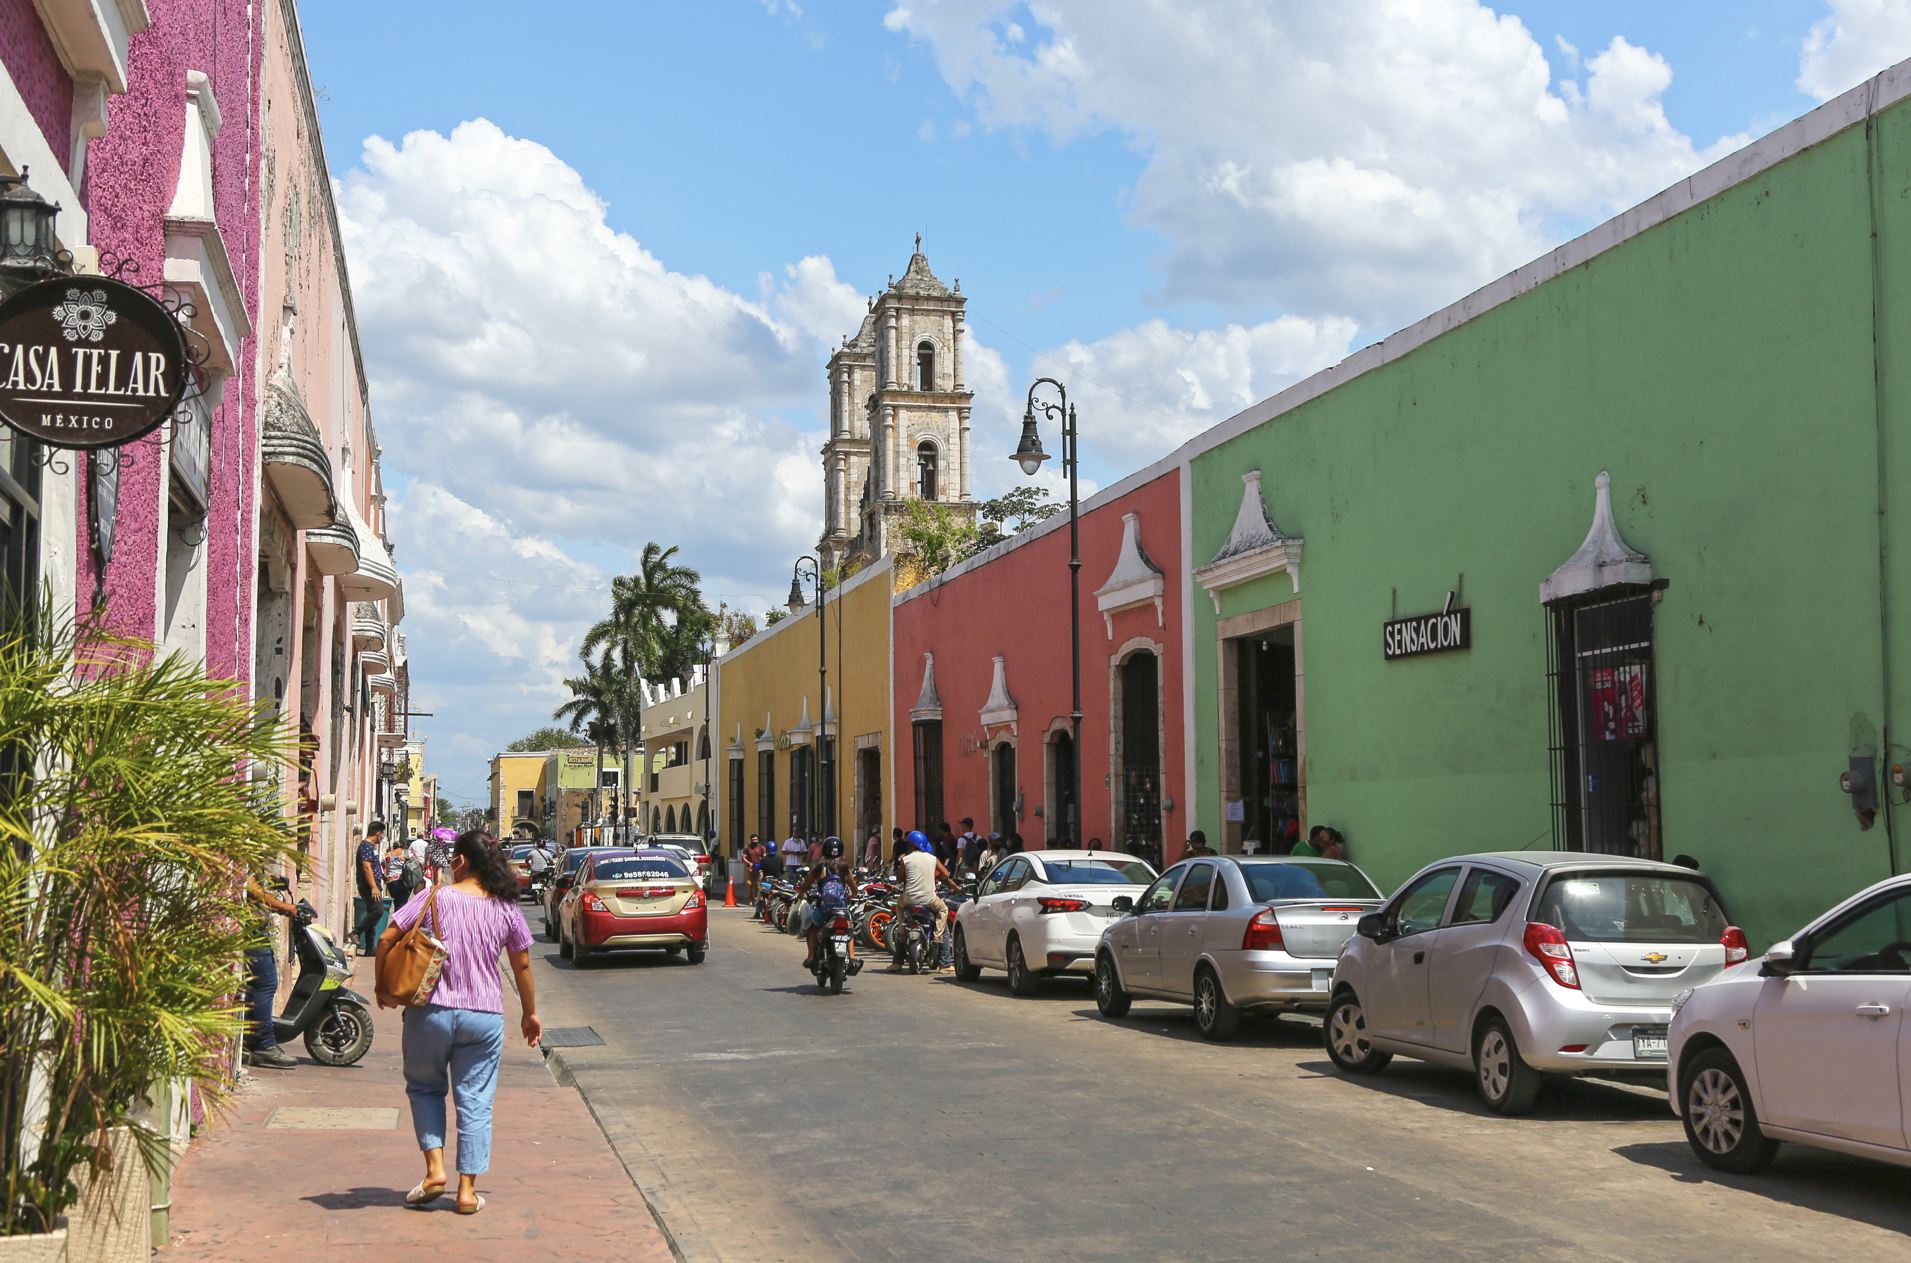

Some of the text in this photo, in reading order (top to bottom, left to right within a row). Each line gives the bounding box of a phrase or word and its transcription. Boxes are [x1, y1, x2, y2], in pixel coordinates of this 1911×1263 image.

[72, 348, 169, 397] TELAR
[41, 413, 113, 430] MÉXICO
[1386, 591, 1460, 655] SENSACIÓN
